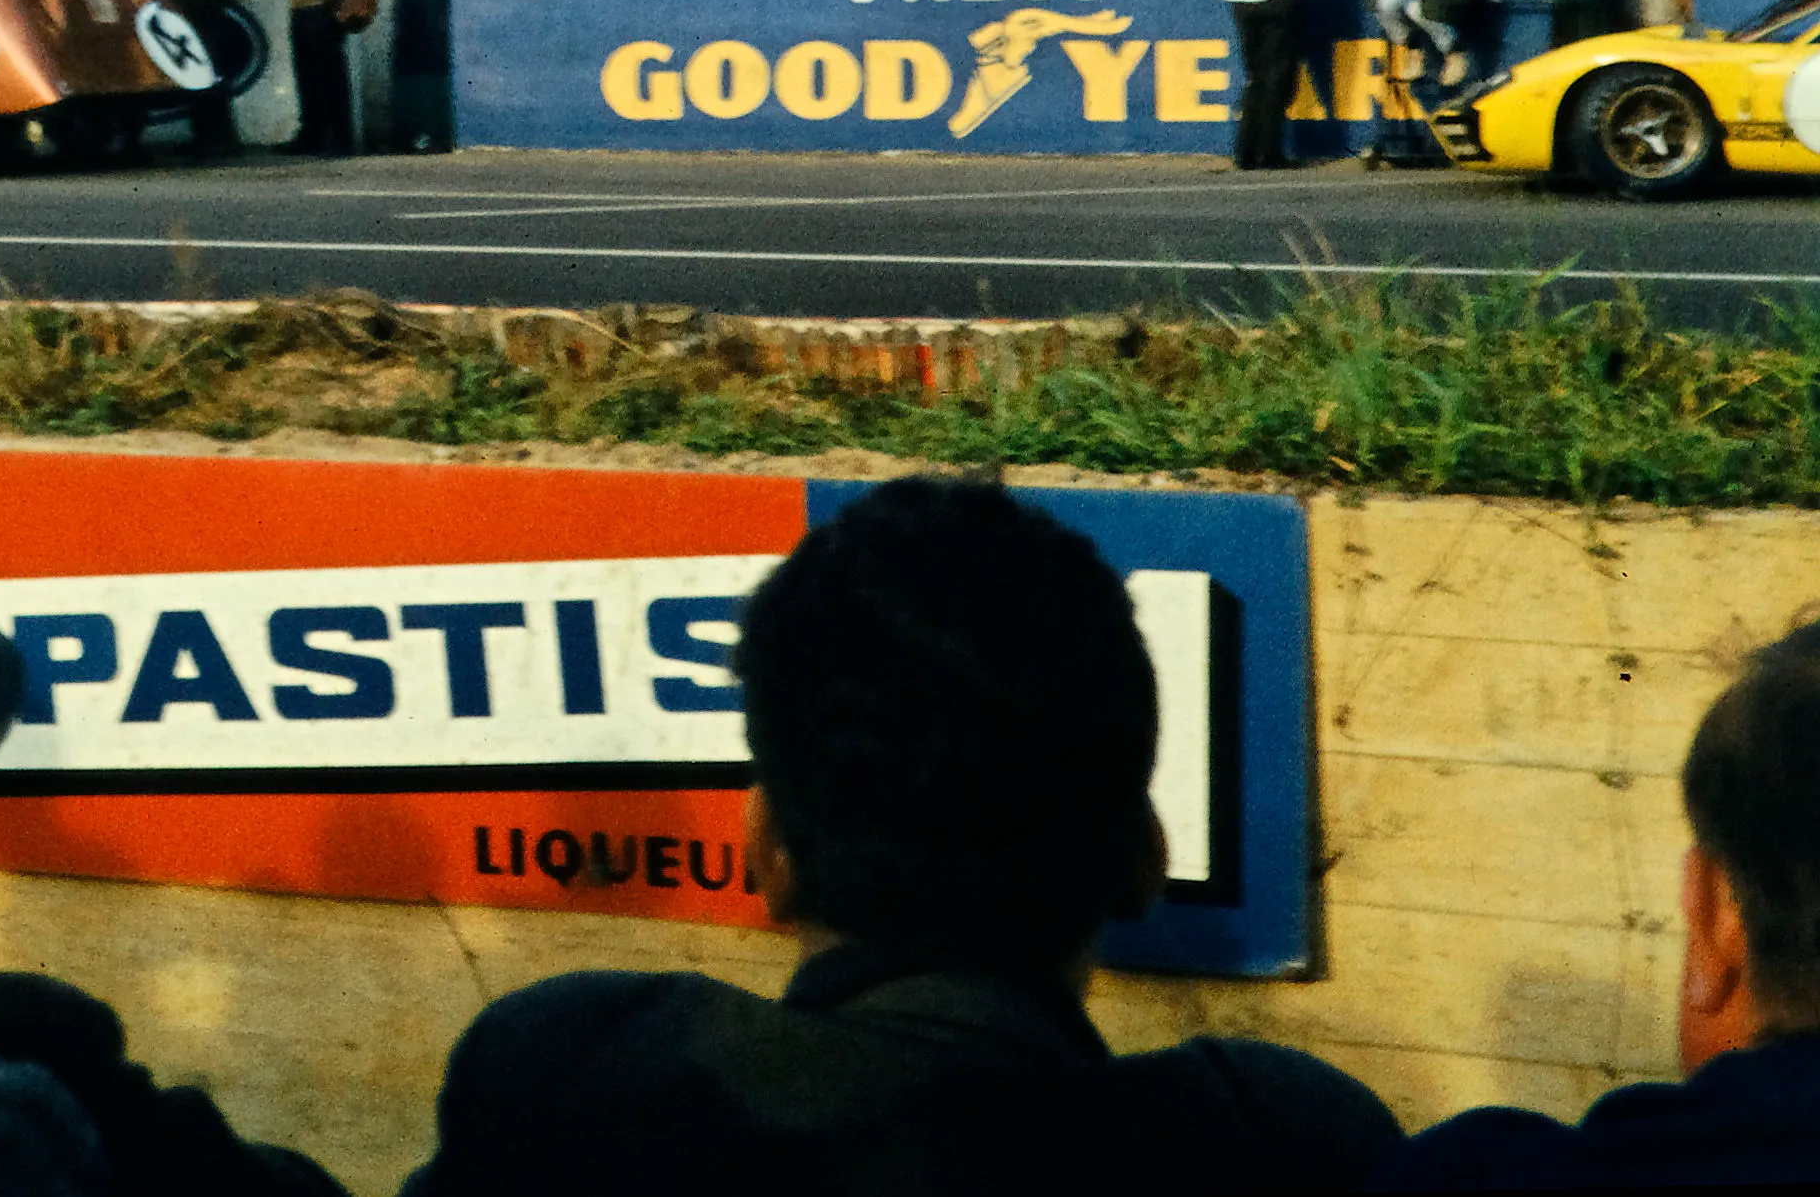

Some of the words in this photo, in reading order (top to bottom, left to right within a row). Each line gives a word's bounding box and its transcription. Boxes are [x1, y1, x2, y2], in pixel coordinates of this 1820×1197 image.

[600, 40, 954, 121] GOOD
[11, 596, 746, 725] PASTIS
[474, 824, 764, 895] LIQUEU
